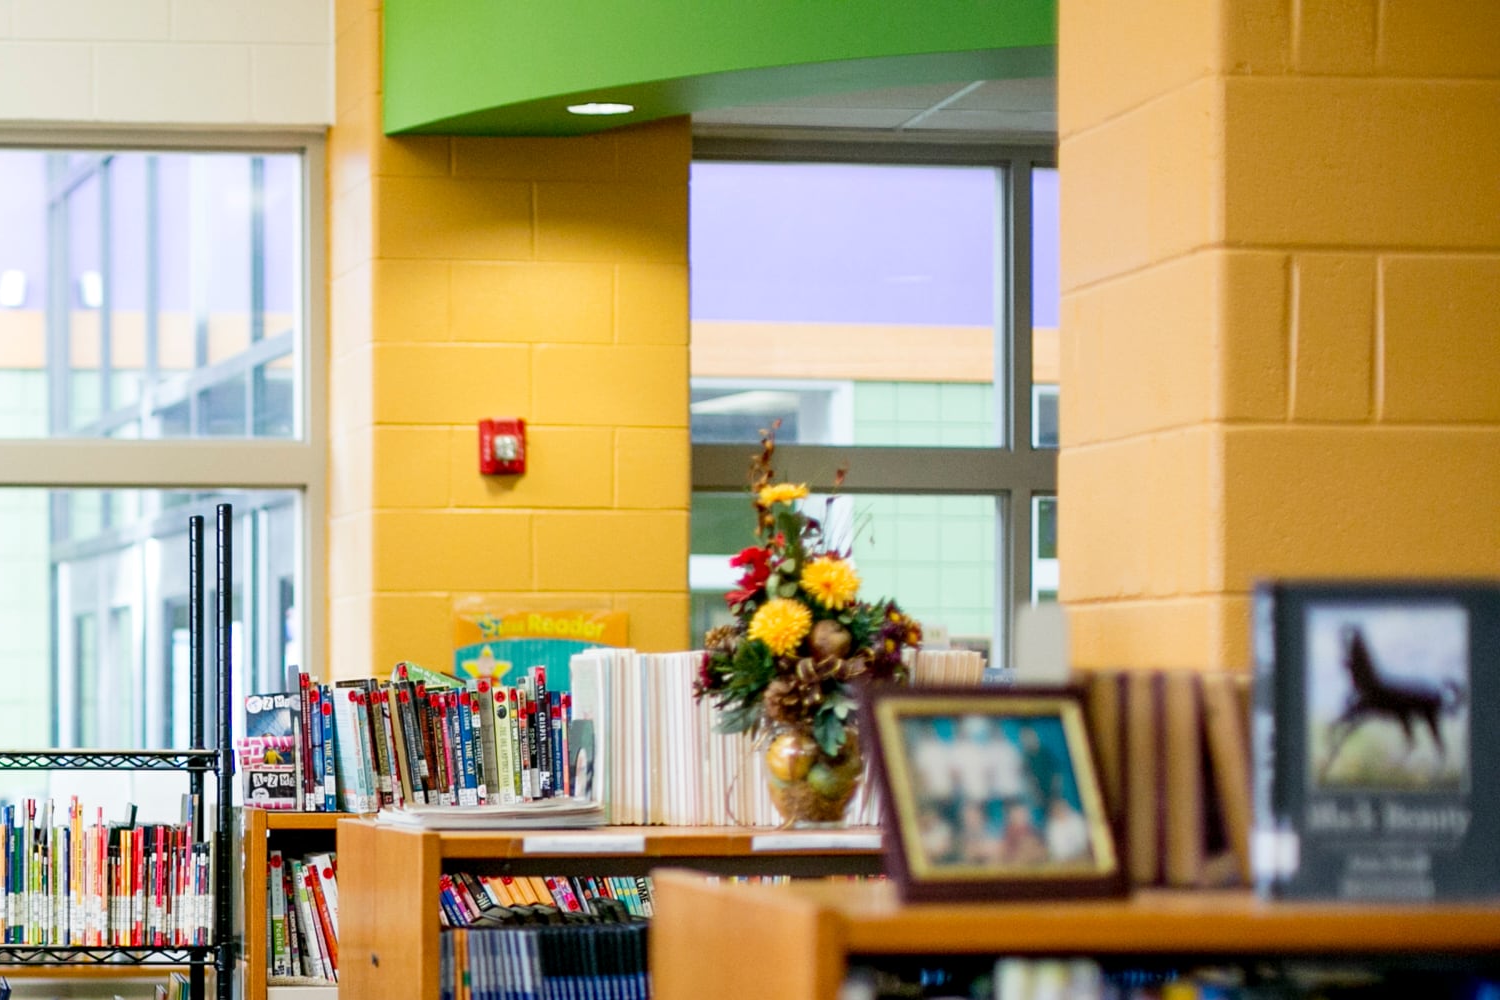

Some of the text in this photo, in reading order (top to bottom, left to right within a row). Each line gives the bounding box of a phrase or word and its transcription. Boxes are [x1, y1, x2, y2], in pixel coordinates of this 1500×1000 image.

[527, 613, 606, 639] Reader
[539, 712, 547, 742] CRISPIN
[324, 738, 333, 775] TIME CAT
[465, 739, 473, 760] TIME
[466, 760, 475, 776] CAT
